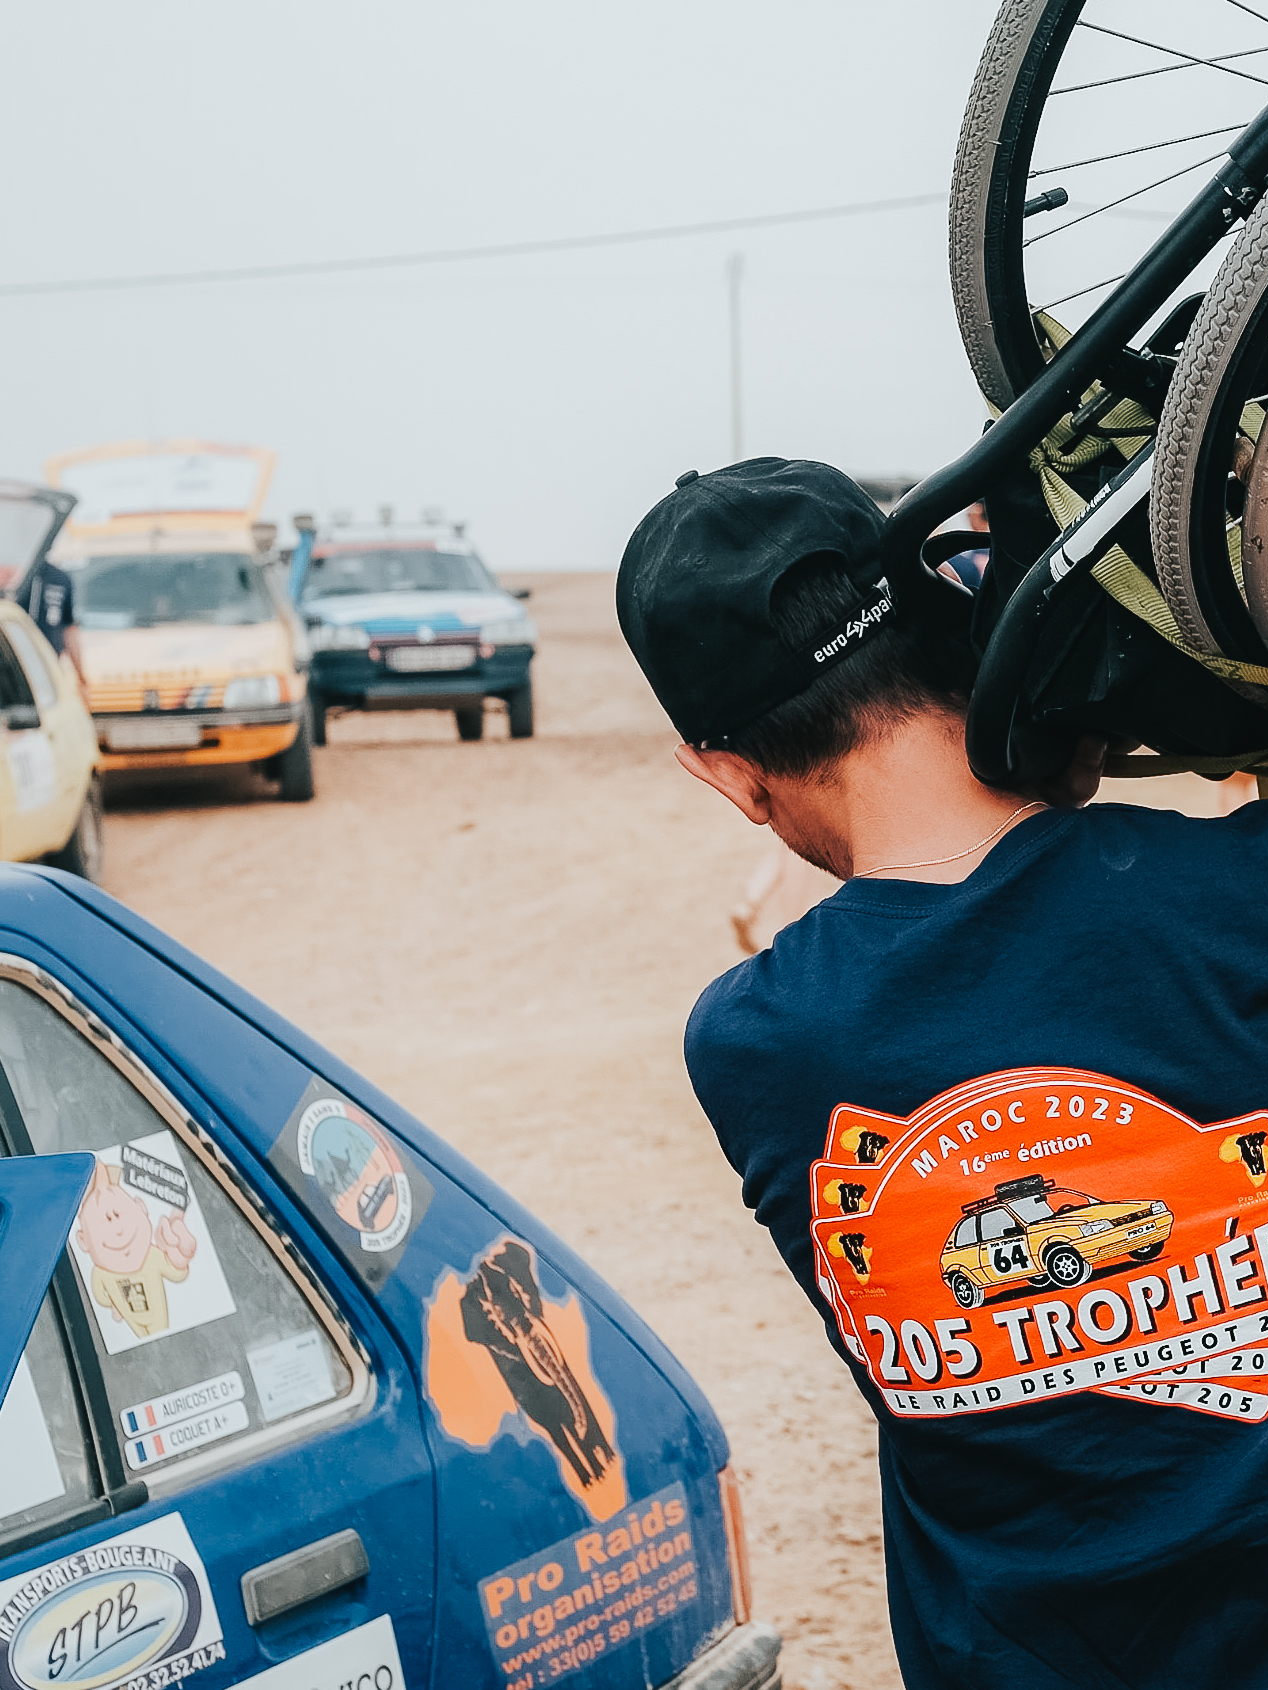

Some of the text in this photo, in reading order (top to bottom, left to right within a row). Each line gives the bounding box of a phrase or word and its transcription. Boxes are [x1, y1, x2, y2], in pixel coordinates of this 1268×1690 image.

[910, 1095, 1135, 1180] MAROC 2023
[959, 1132, 1093, 1176] 16ème édition
[993, 1243, 1029, 1274] 64
[864, 1314, 982, 1385] 205
[894, 1392, 921, 1411] LE
[933, 1385, 1002, 1411] RAID
[1020, 1367, 1076, 1395] DES
[1093, 1325, 1238, 1379] PEUGEOT
[162, 1384, 219, 1418] AURICOSTE
[168, 1419, 212, 1447] COQUET
[1197, 1387, 1253, 1413] 205
[484, 1499, 685, 1618] Pro Raids
[495, 1531, 692, 1648] organisation
[47, 1581, 138, 1680] STPB
[502, 1560, 696, 1675] www.pro-raids.com
[548, 1632, 606, 1677] 33(0)5
[608, 1618, 631, 1644] 59
